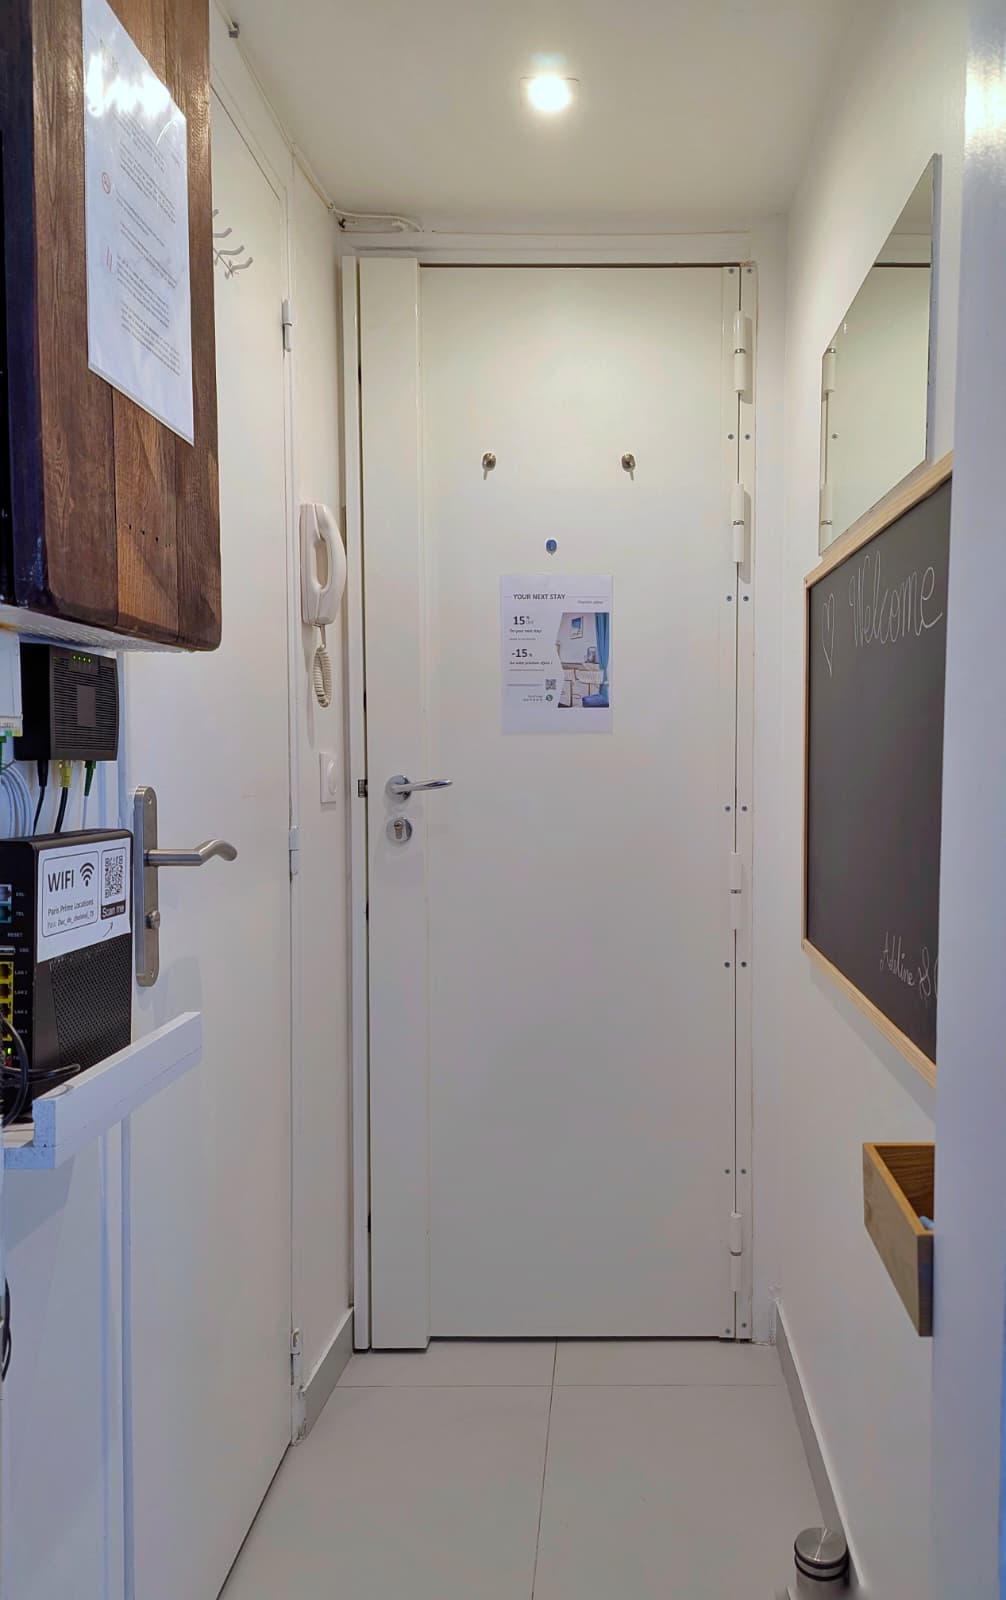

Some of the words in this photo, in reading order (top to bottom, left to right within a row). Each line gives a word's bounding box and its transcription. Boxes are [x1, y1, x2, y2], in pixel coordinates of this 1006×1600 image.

[513, 593, 532, 601] YOUR
[532, 593, 549, 601] NEXT
[549, 593, 566, 601] STAY
[848, 550, 943, 648] Welcome
[513, 615, 526, 625] 15
[511, 648, 528, 658] -15
[47, 869, 75, 893] WIFI
[47, 905, 60, 917] Paris
[60, 902, 74, 914] Prime
